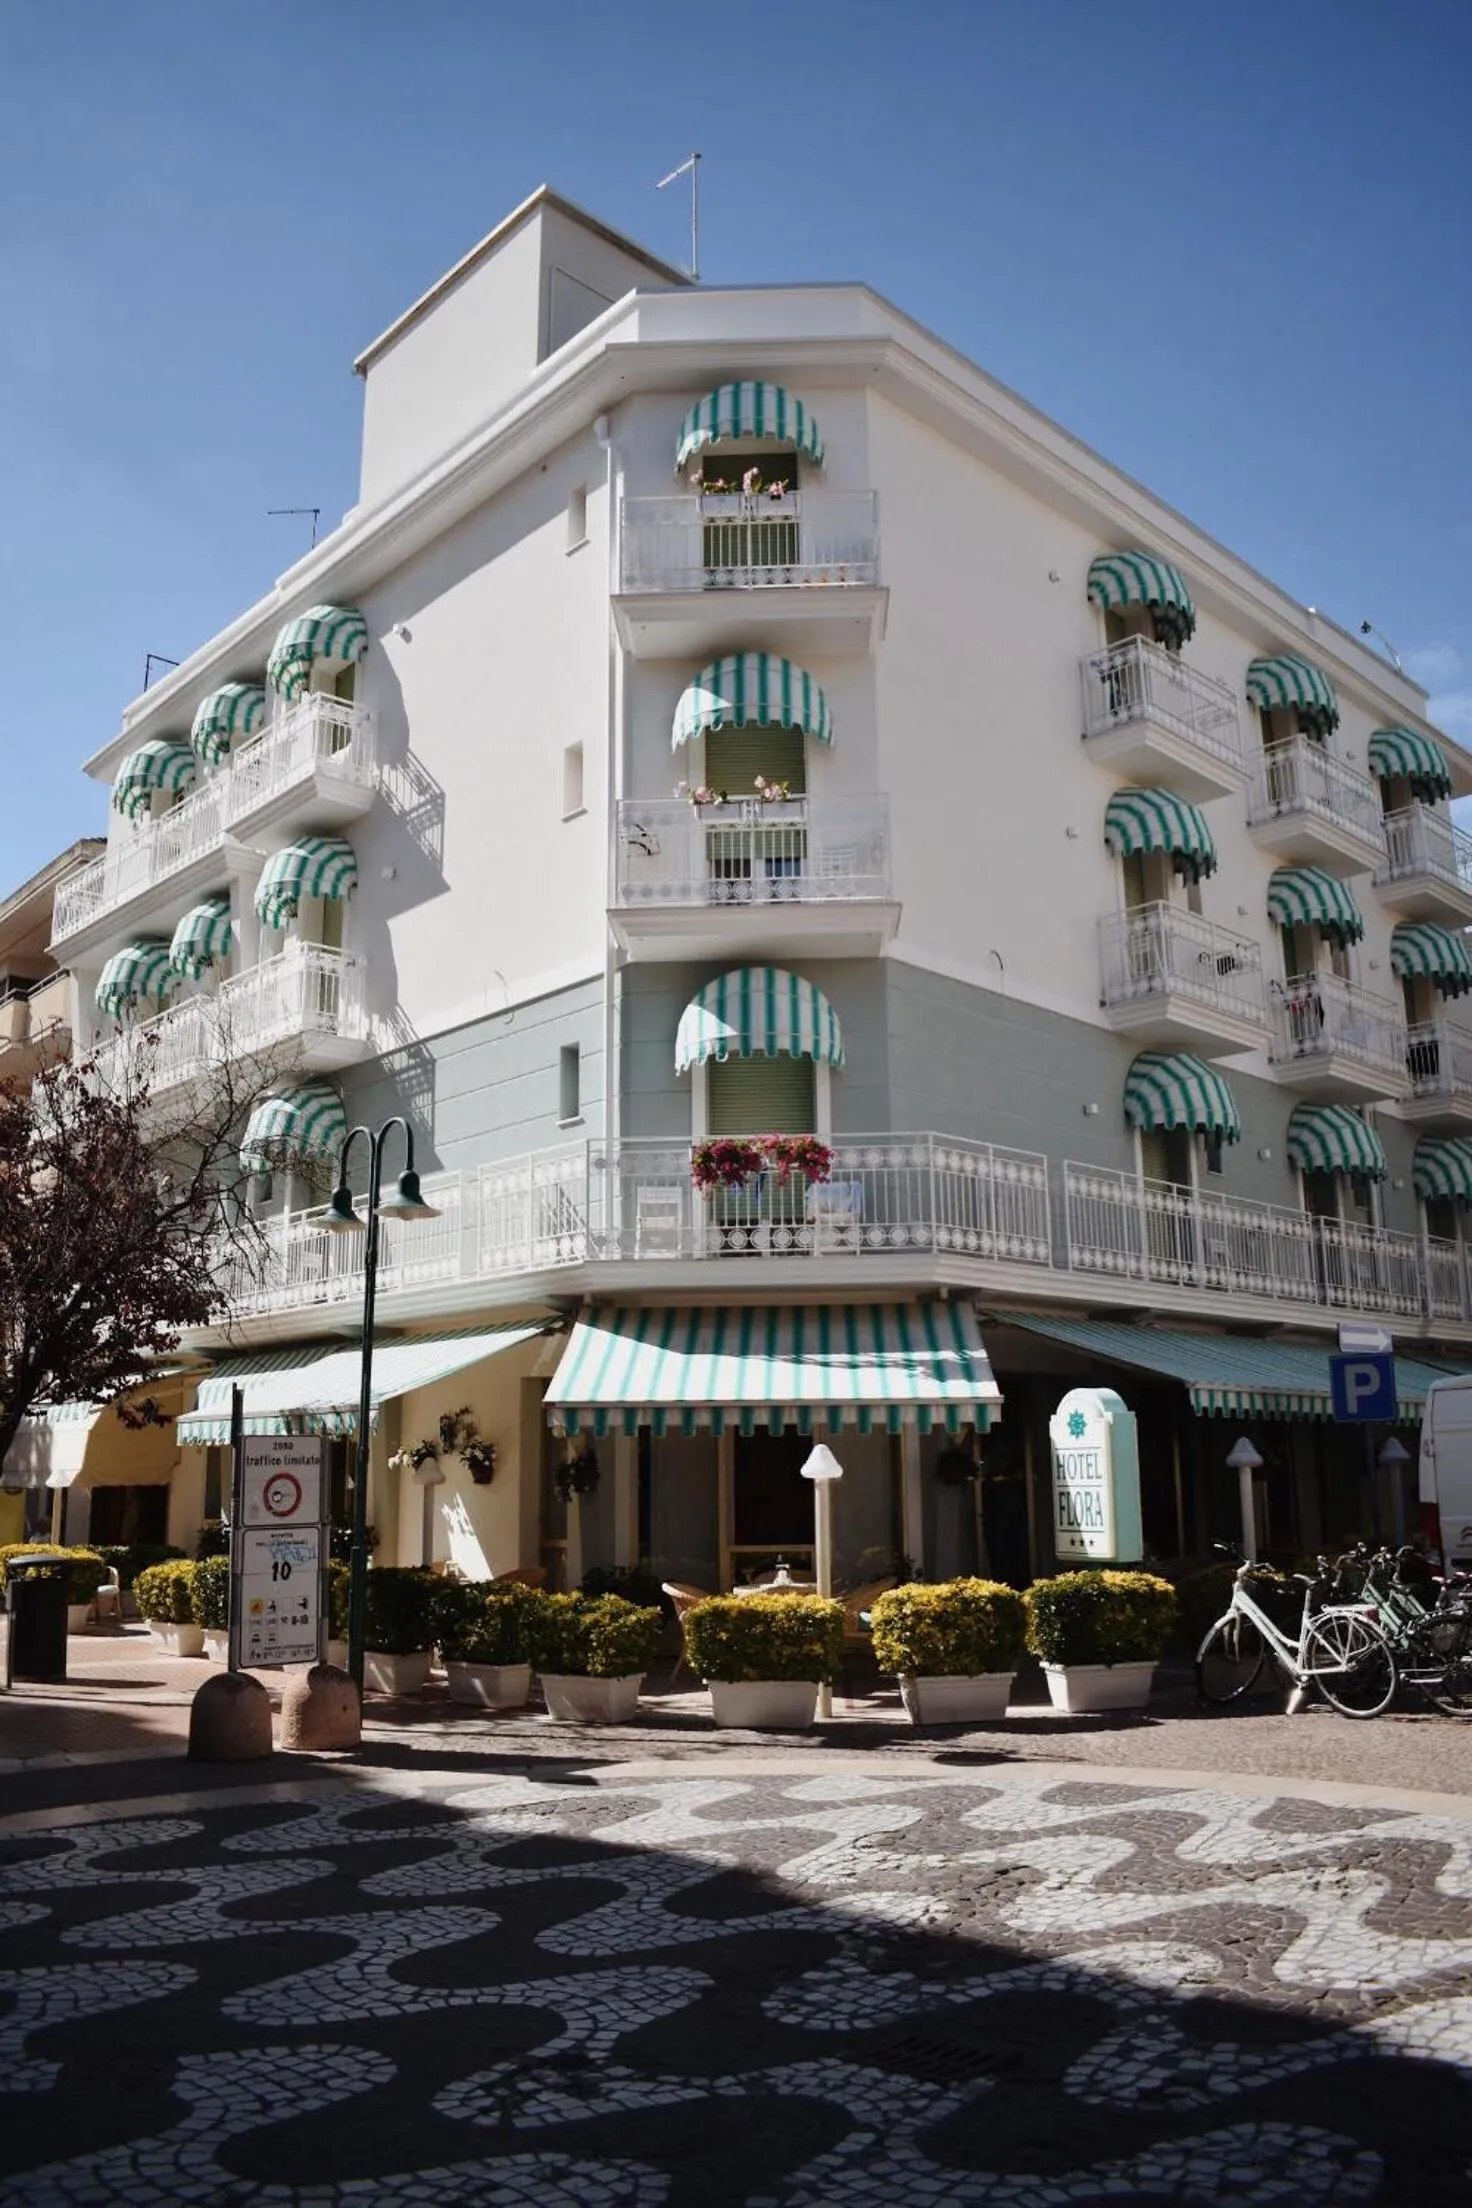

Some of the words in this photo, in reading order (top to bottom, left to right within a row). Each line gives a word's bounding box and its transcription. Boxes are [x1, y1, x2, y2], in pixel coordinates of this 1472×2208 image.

[1344, 1362, 1381, 1414] P
[246, 1454, 282, 1467] traffico
[283, 1453, 320, 1467] limitato
[1056, 1453, 1103, 1480] HOTEL
[1059, 1491, 1104, 1527] FLORA
[272, 1561, 292, 1582] 10
